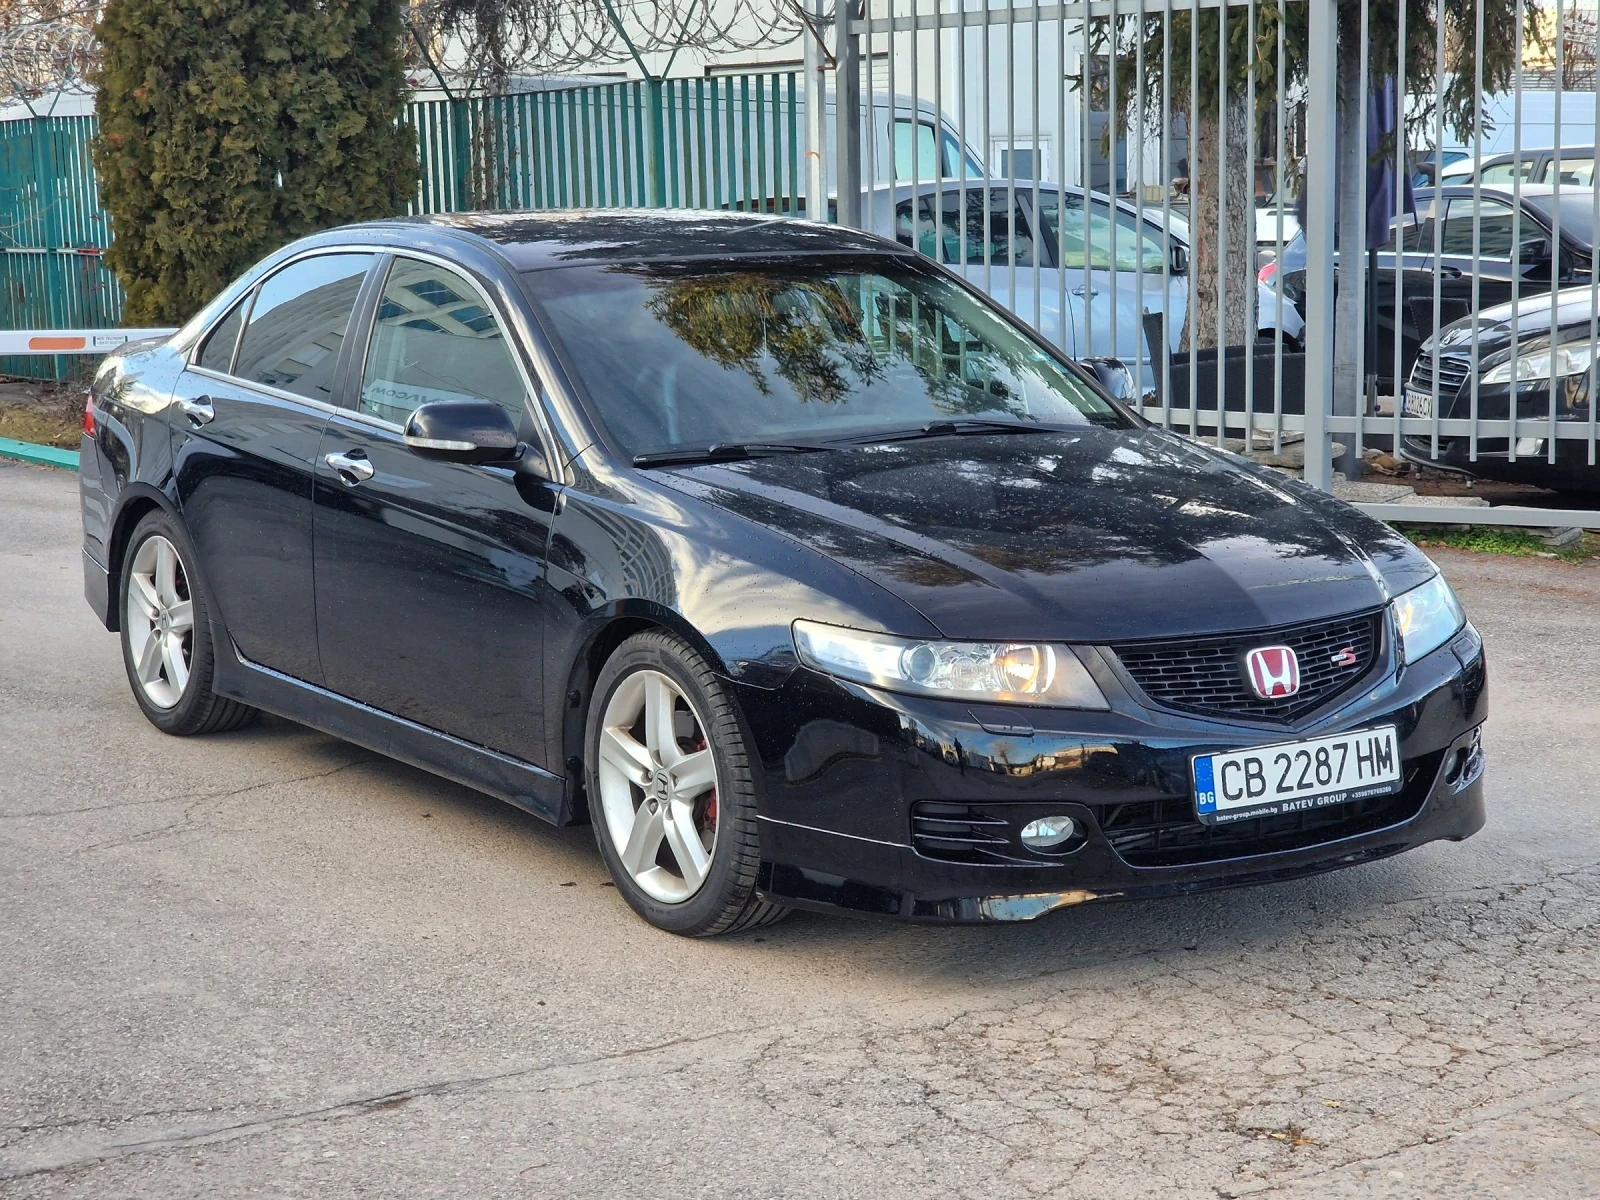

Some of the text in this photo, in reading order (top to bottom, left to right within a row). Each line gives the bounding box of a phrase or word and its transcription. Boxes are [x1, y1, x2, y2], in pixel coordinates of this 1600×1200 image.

[1220, 734, 1394, 801] CB 2287 HM
[1199, 791, 1214, 805] BG
[1216, 807, 1278, 822] batev-group.mobile.bg
[1282, 798, 1314, 812] BATEV
[1316, 793, 1348, 806] GROUP
